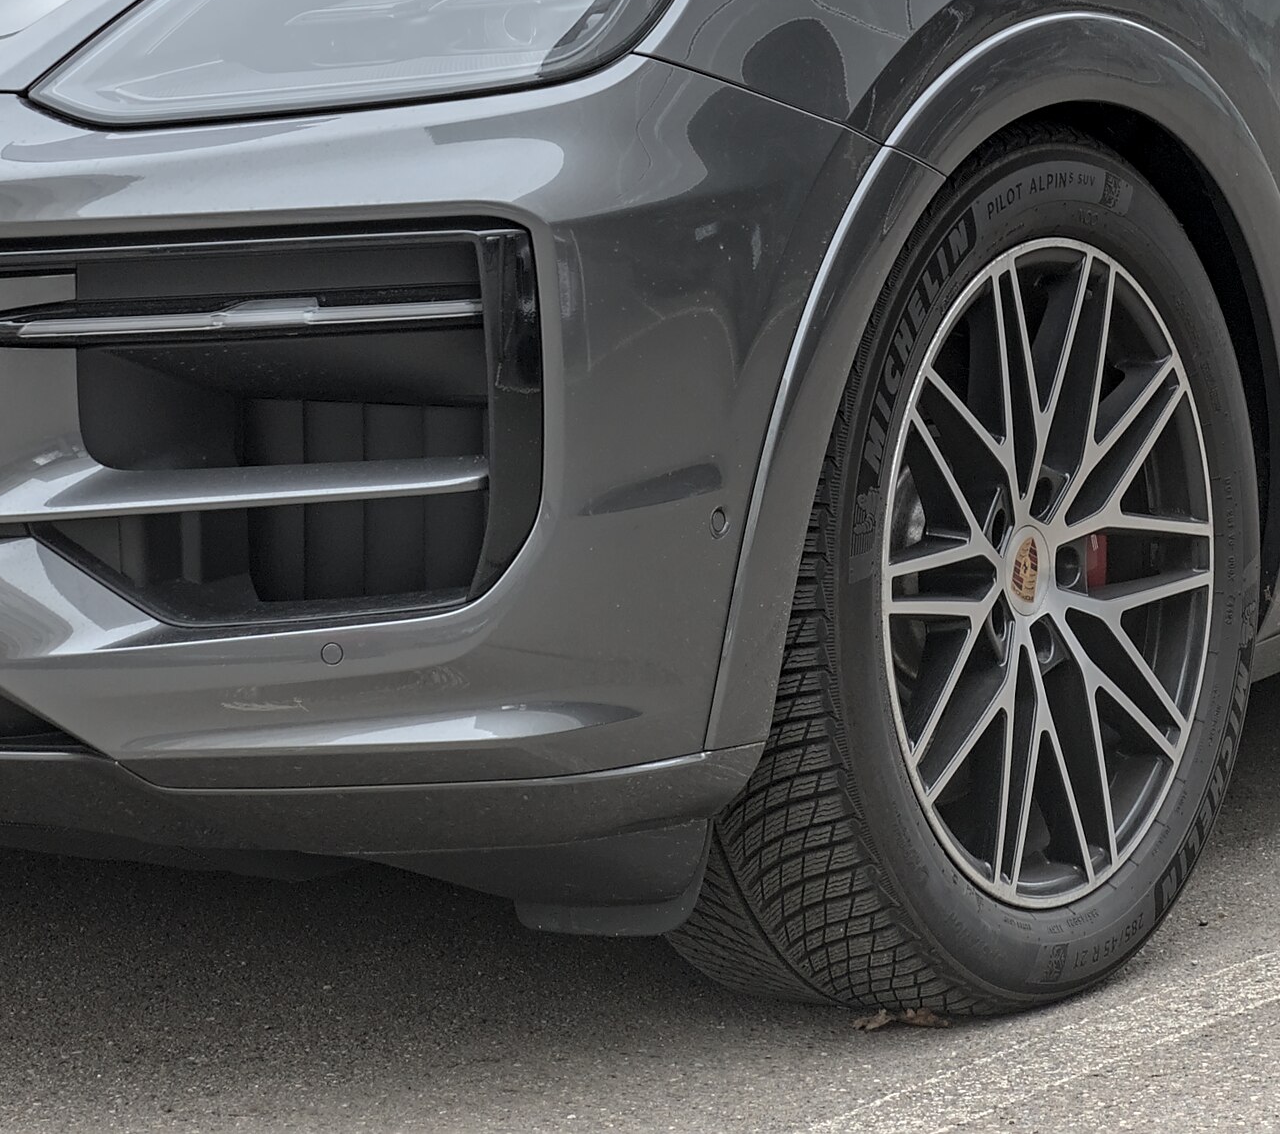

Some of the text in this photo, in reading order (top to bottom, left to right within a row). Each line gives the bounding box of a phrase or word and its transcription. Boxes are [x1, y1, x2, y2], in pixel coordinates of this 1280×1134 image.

[986, 181, 1024, 220] PILOT
[1077, 173, 1096, 187] SUV
[862, 219, 972, 468] MICHELIN
[1161, 662, 1250, 905] MICHELIN
[1091, 947, 1101, 964] R
[1104, 912, 1145, 956] 285/45
